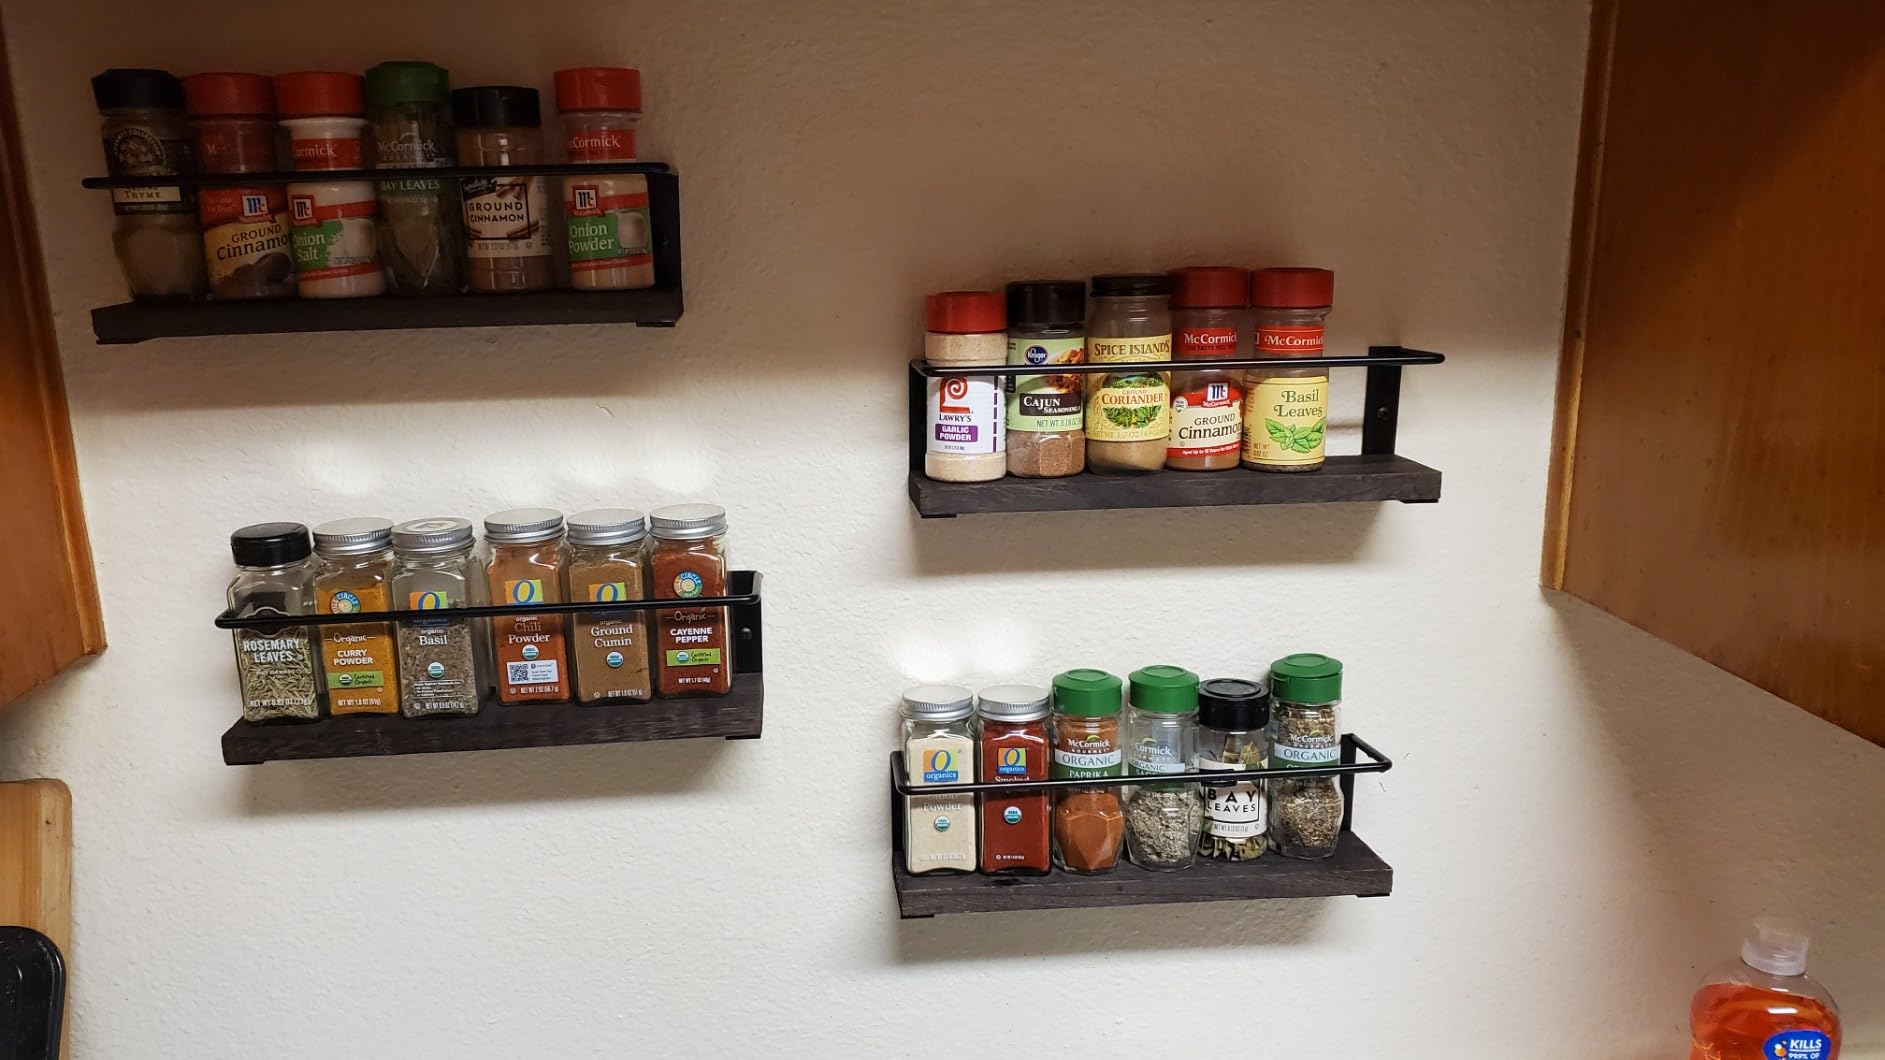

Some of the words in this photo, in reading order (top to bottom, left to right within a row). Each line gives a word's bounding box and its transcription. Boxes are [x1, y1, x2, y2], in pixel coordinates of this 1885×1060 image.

[377, 139, 441, 153] McCormick
[571, 136, 621, 149] Cormick
[295, 144, 337, 157] ormick
[400, 179, 440, 191] LEAVES
[124, 191, 161, 199] THYME
[468, 203, 523, 212] GROUND
[470, 214, 524, 223] CINNAMON
[231, 224, 282, 243] GROUND
[569, 224, 608, 238] Onion
[293, 232, 325, 248] Onion
[568, 238, 614, 254] Powder
[216, 234, 289, 260] Cinnamo
[297, 247, 319, 262] Salt
[1094, 343, 1126, 356] SPICE
[1129, 340, 1169, 354] ISLANDS
[1028, 348, 1046, 363] Kroger
[1101, 393, 1164, 405] CORIANDER
[1281, 389, 1319, 403] Basil
[1023, 396, 1061, 409] CAJUN
[1273, 404, 1323, 417] Leaves
[939, 413, 972, 422] LAWRY'S
[1194, 413, 1235, 425] GROUND
[680, 571, 702, 585] CIRCLE
[336, 591, 360, 606] CIRCLE
[674, 610, 706, 623] Organic
[514, 622, 542, 632] Chili
[591, 624, 633, 637] Ground
[670, 627, 713, 636] CAYENNE
[243, 638, 300, 651] ROSEMARY
[334, 633, 367, 645] Organic
[419, 635, 448, 647] Basil
[508, 634, 551, 644] Powder
[594, 637, 632, 648] Cumin
[675, 636, 709, 644] PEPPER
[254, 651, 293, 663] LEAVES
[337, 649, 367, 658] CURRY
[333, 657, 374, 666] POWDER
[1067, 738, 1110, 748] McCormick
[1289, 733, 1334, 743] McCormick
[1135, 743, 1173, 756] Cormick
[1284, 748, 1335, 761] ORGANIC
[1062, 754, 1114, 766] ORGANIC
[1132, 760, 1164, 771] ORGANIC
[926, 772, 957, 781] organics
[1069, 769, 1109, 778] PAPRIKA
[1208, 788, 1256, 803] BAY
[1207, 801, 1256, 813] LEAVES
[1790, 1039, 1822, 1049] KILLS
[1788, 1052, 1808, 1060] 99.9%
